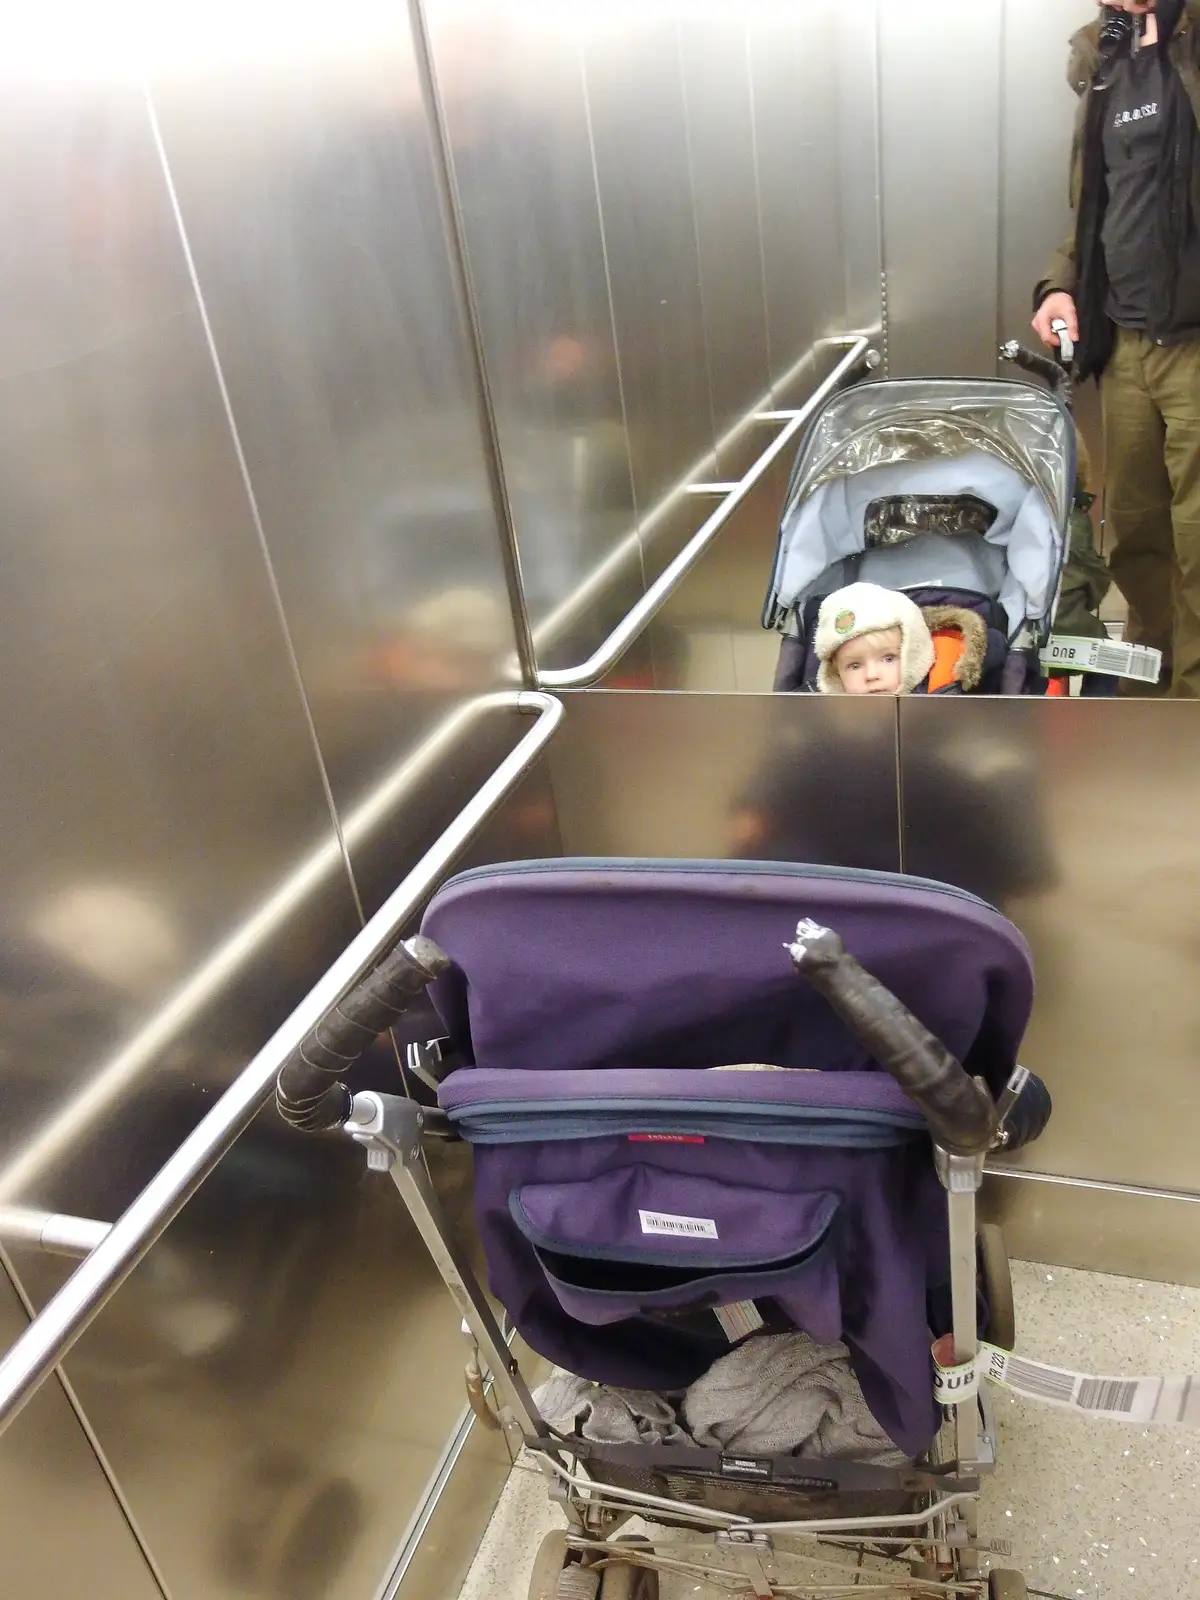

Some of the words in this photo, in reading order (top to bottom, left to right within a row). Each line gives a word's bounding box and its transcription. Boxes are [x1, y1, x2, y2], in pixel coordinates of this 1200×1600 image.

[991, 1352, 1005, 1369] 223
[934, 1370, 974, 1389] DUB
[988, 1368, 1002, 1380] FR
